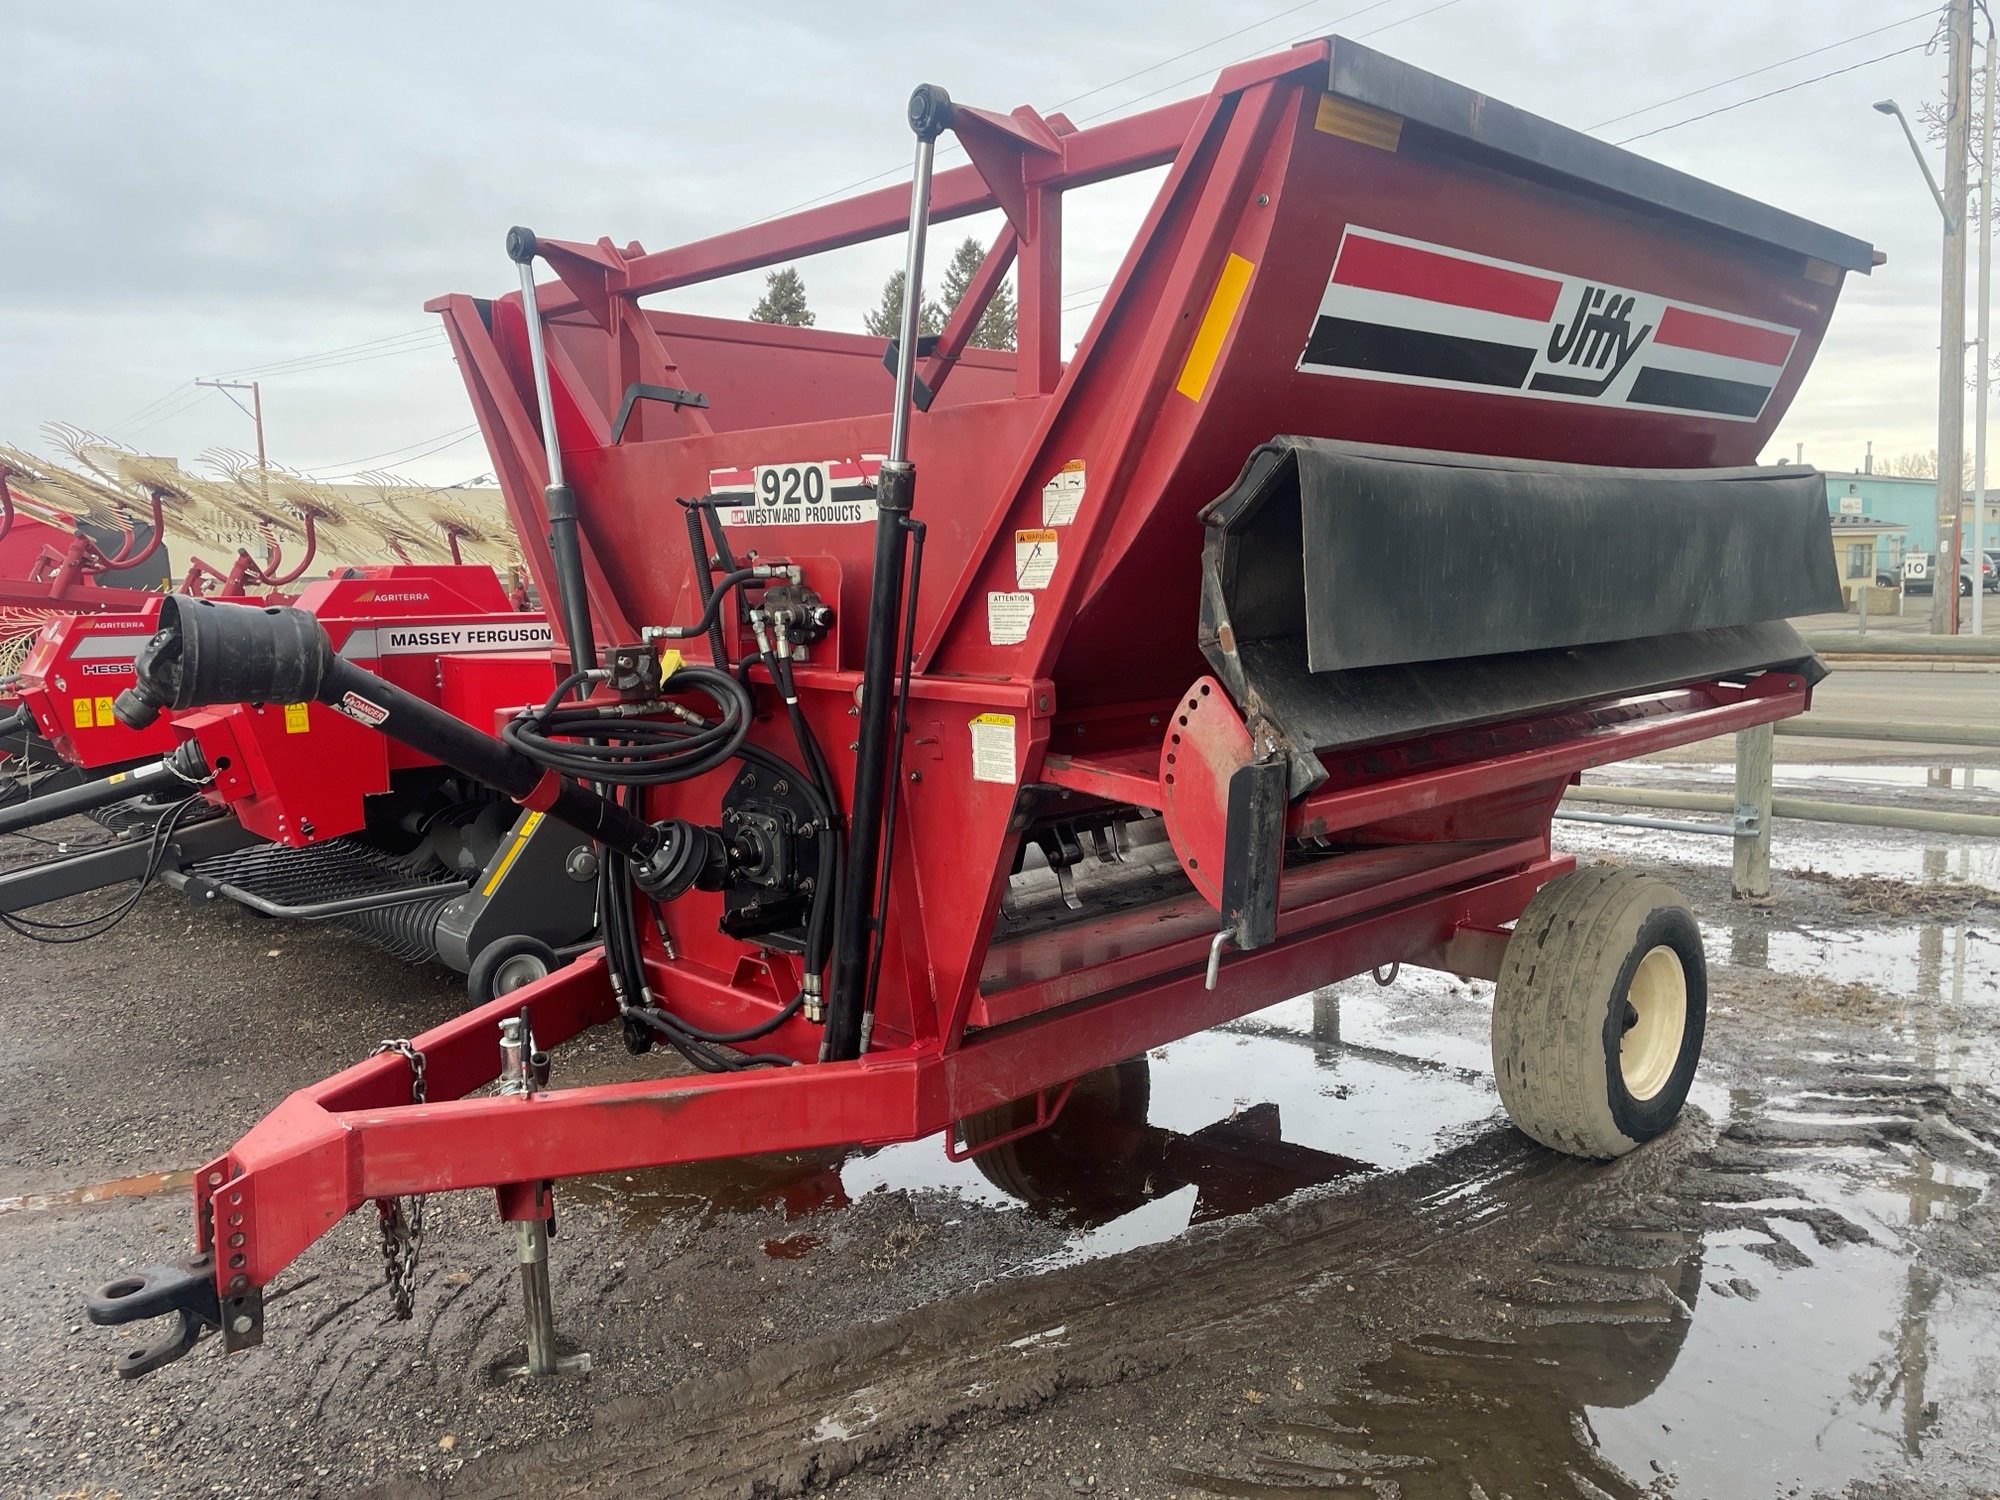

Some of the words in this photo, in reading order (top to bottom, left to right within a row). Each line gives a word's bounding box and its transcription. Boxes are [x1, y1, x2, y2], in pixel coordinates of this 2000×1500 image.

[1528, 285, 1653, 398] Jiffy
[761, 466, 824, 507] 920
[746, 507, 801, 525] WESTWARD
[805, 504, 862, 523] PRODUCTS
[1907, 562, 1925, 575] 10
[374, 592, 430, 602] AGRITERRA
[993, 594, 1030, 602] ATTENTION
[94, 621, 145, 629] AGRITERRA
[391, 631, 462, 647] MASSEY
[467, 628, 552, 644] FERGUSON
[83, 664, 136, 675] HESS
[353, 700, 385, 720] DANGER
[985, 716, 1010, 725] CAUTION
